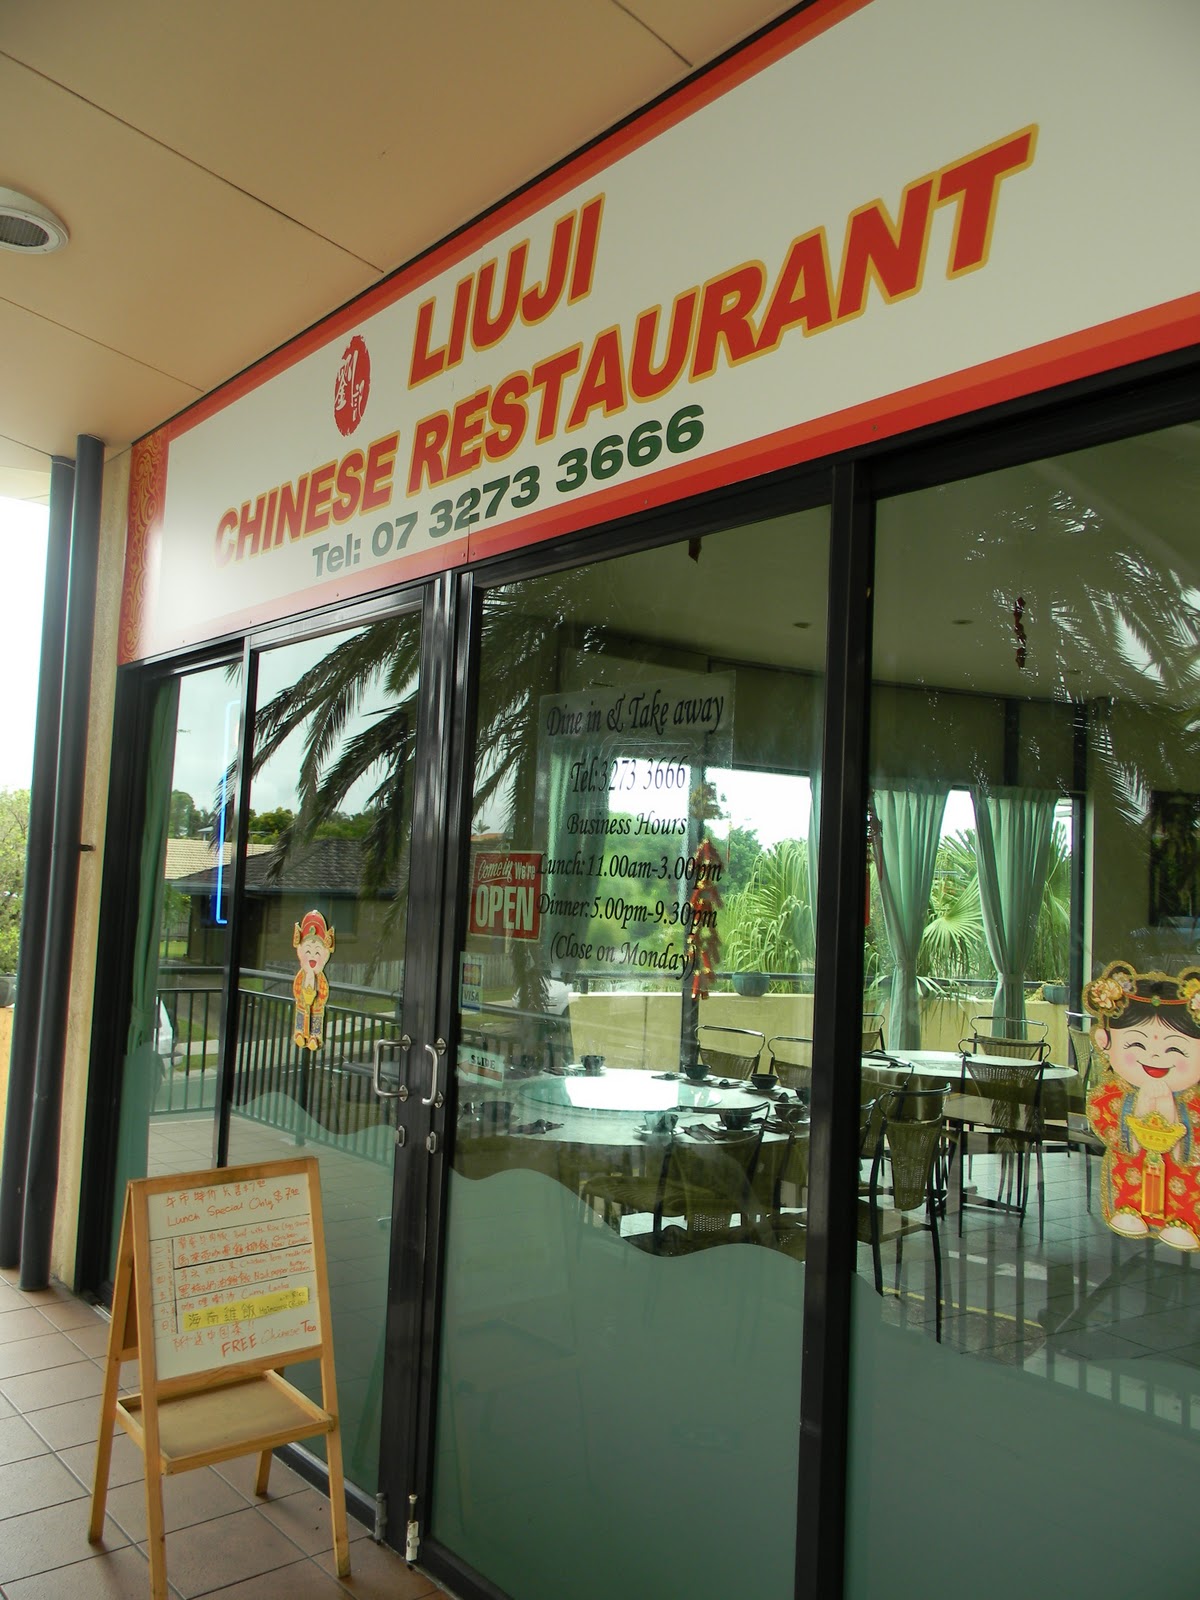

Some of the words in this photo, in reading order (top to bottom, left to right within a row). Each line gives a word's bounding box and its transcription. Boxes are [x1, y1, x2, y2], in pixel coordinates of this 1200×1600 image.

[408, 193, 605, 389] LIUJI
[215, 431, 400, 568] CHINESE
[405, 124, 1038, 497] RESTAURANT
[312, 533, 361, 577] Tel:
[371, 511, 418, 557] 07
[428, 465, 540, 538] 3273
[555, 404, 705, 492] 3666
[546, 705, 582, 736] Dine
[586, 701, 602, 732] in
[628, 689, 669, 735] Take
[673, 695, 724, 735] away
[643, 755, 688, 789] 3666
[567, 812, 631, 835] Business
[634, 810, 687, 836] Hours
[478, 860, 503, 881] Come
[501, 857, 512, 877] in
[515, 861, 535, 880] We're
[475, 885, 534, 931] OPEN
[550, 931, 593, 963] (Close
[596, 944, 616, 962] on
[619, 942, 697, 981] Monday)
[463, 990, 480, 1002] VISA
[471, 1054, 496, 1070] SLIDE
[168, 1213, 200, 1227] Lunch
[207, 1202, 243, 1219] Special
[249, 1197, 274, 1211] Only
[221, 1333, 257, 1357] FREE
[301, 1319, 317, 1333] Tea
